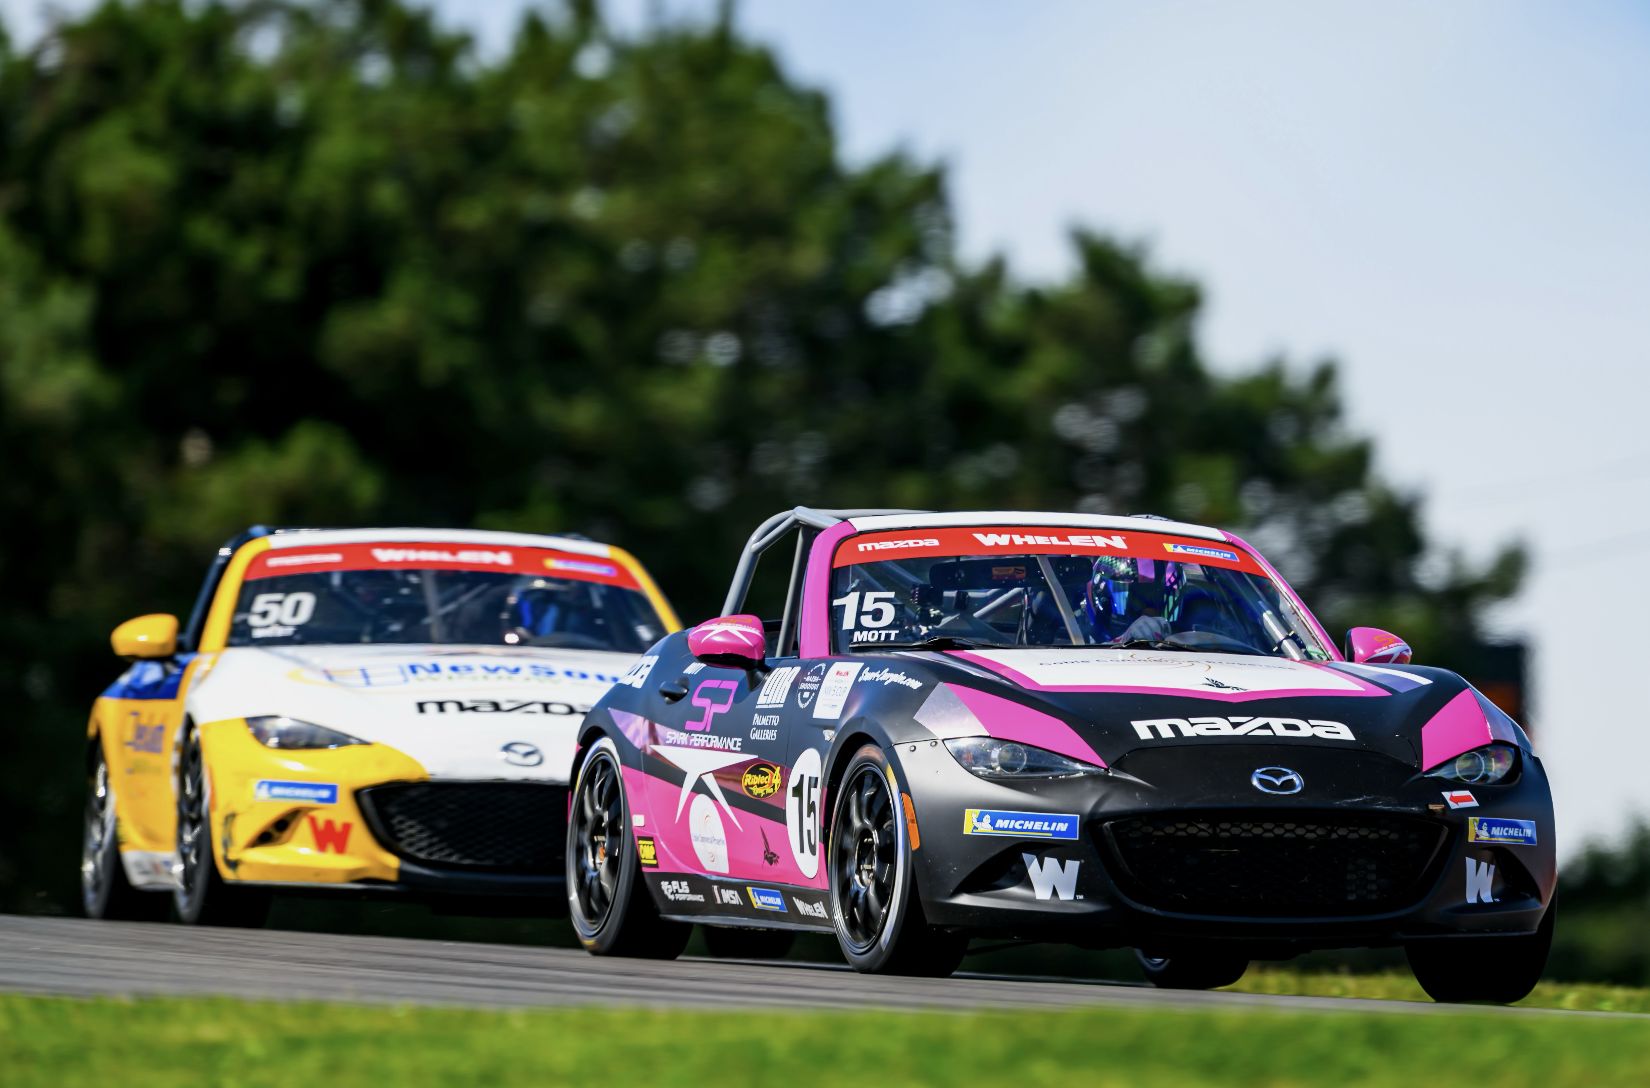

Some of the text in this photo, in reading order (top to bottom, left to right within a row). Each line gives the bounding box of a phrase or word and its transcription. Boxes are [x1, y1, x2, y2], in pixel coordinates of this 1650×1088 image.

[972, 533, 1128, 549] WHELEN
[1186, 547, 1231, 558] MICHELIN
[247, 592, 317, 627] 50
[832, 591, 896, 630] 15
[853, 630, 900, 642] MOTT
[684, 679, 739, 732] SP
[750, 727, 778, 740] GALLERIES
[1130, 716, 1356, 741] mazda
[666, 731, 743, 751] SPARK PERFORMANCE
[792, 774, 819, 856] 15
[995, 819, 1069, 832] MICHELIN
[305, 813, 352, 855] W
[1490, 826, 1532, 837] MICHELIN
[1021, 852, 1080, 900] W
[1465, 856, 1495, 904] W
[759, 895, 782, 906] MICHELIN
[792, 896, 829, 919] WHELEN
